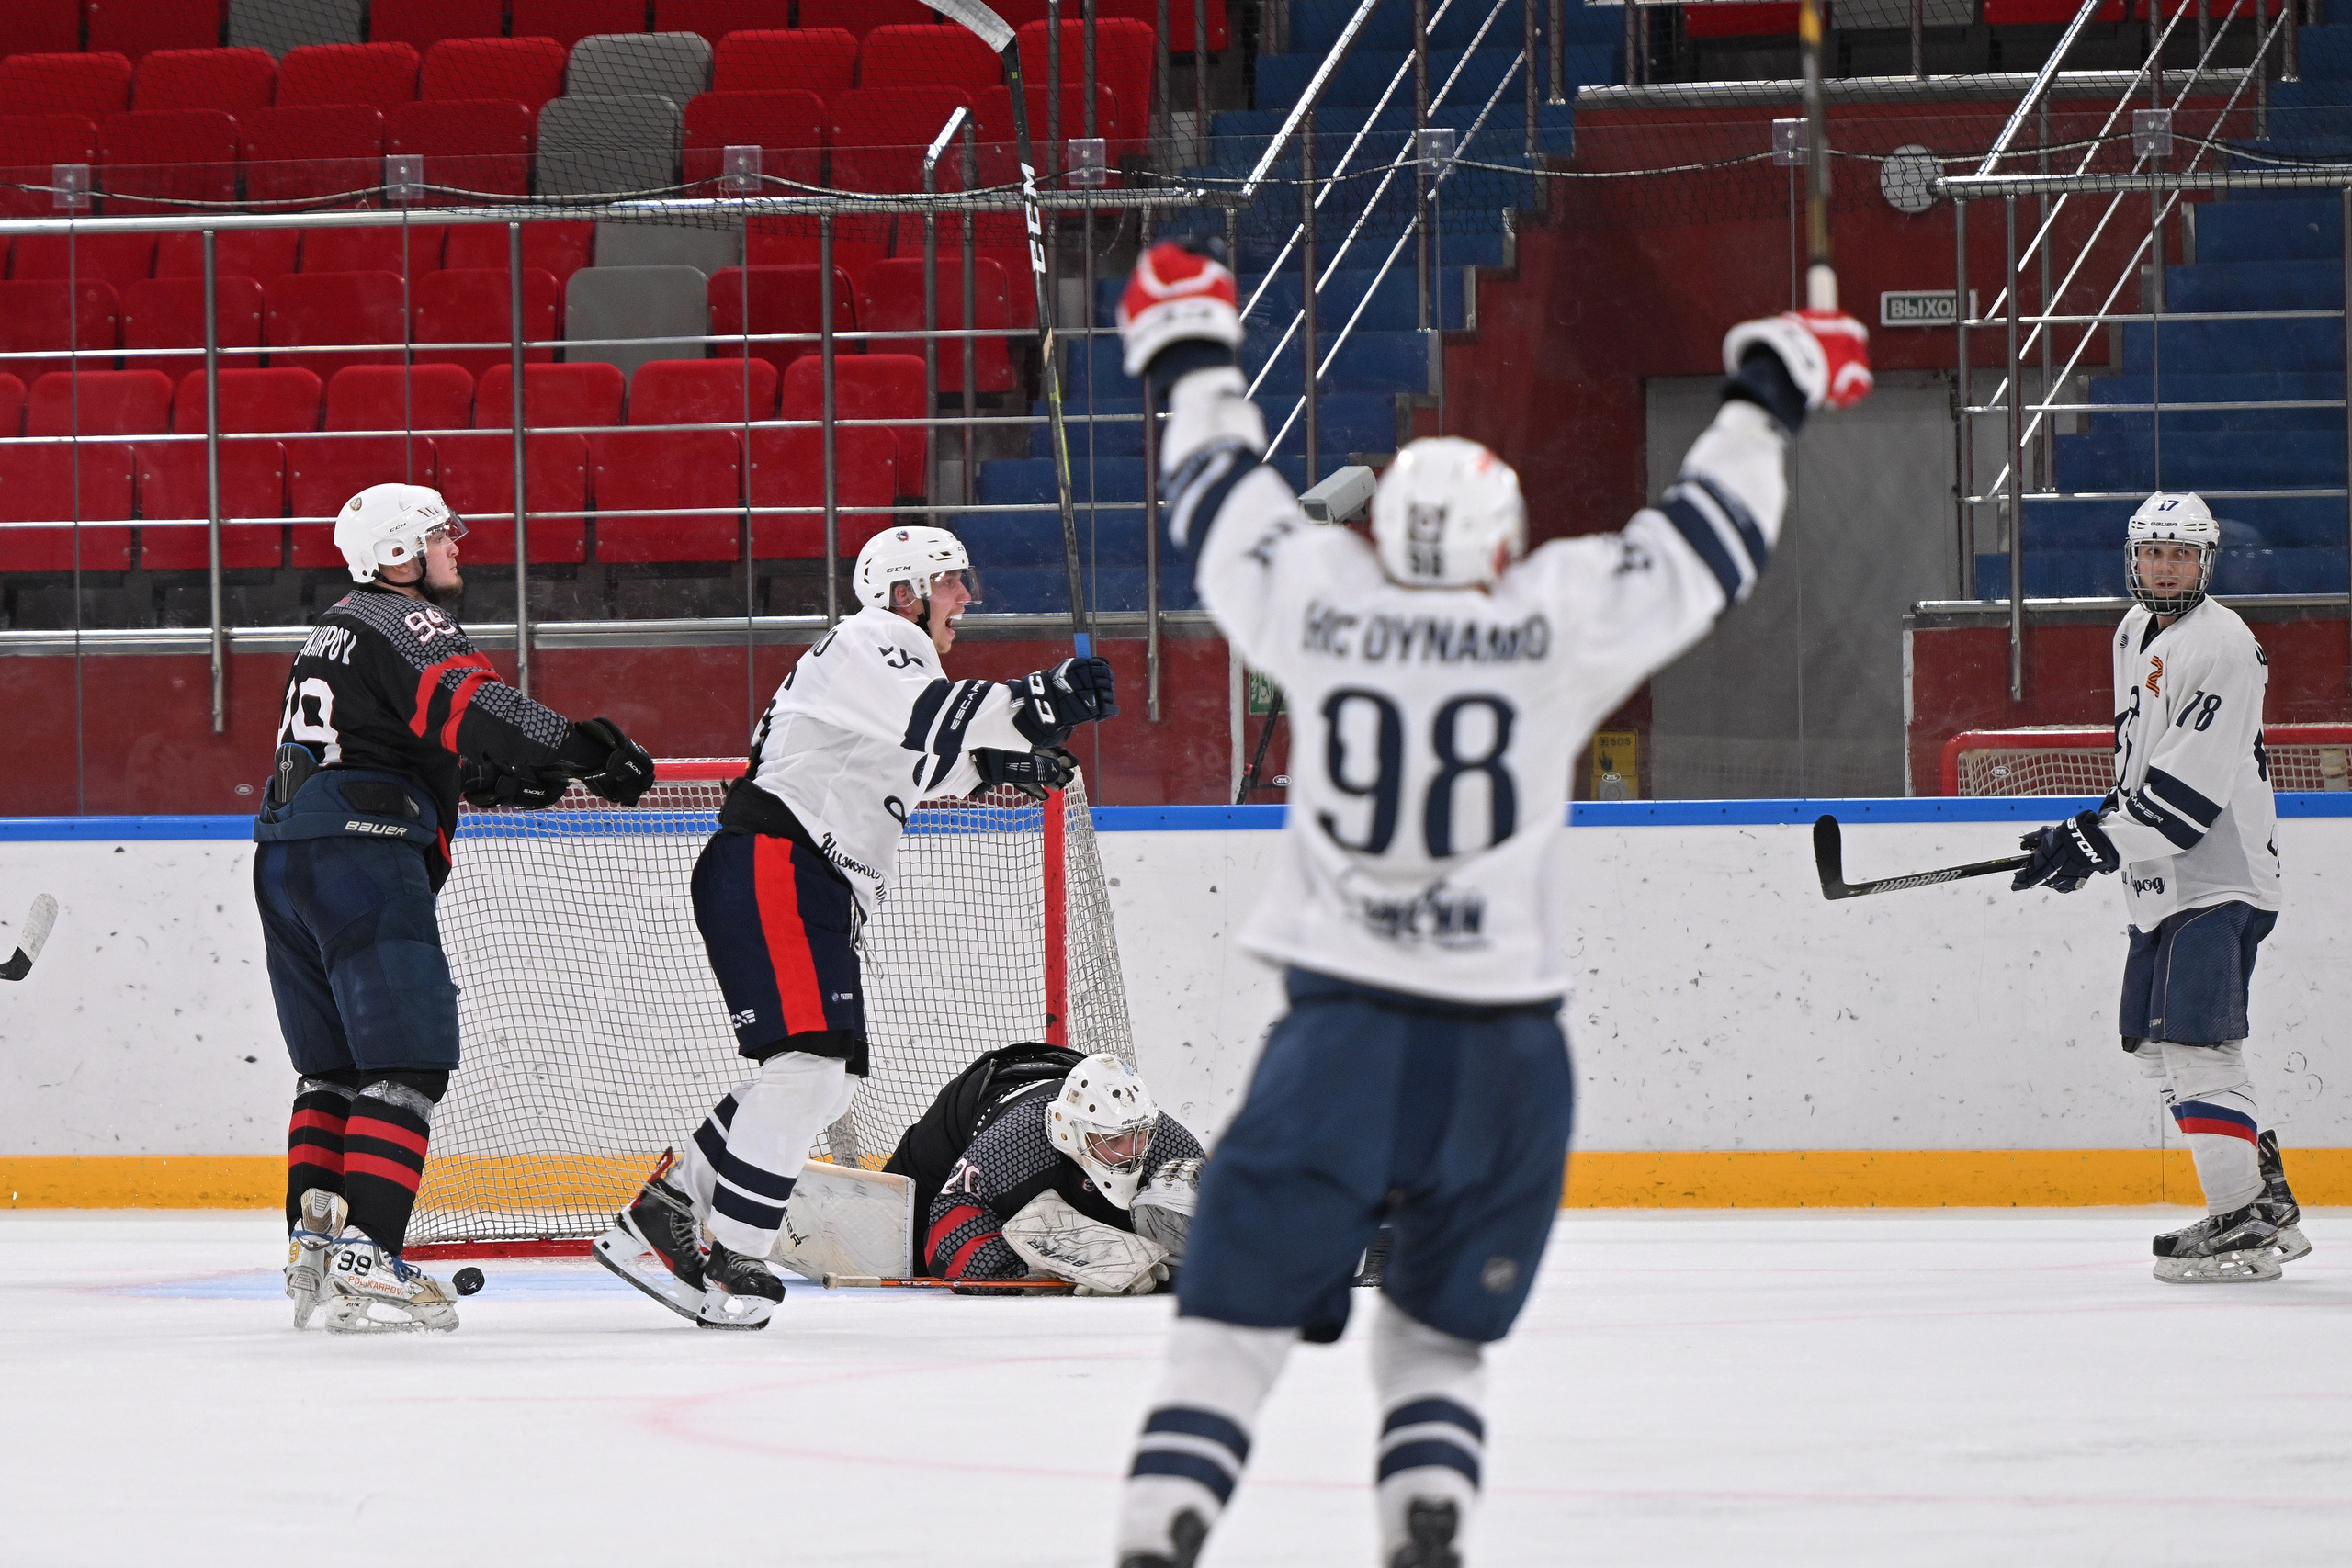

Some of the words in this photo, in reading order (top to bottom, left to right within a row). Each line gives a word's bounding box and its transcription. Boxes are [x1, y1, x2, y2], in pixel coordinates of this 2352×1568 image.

[1021, 162, 1046, 273] CCM
[2158, 500, 2180, 511] 17
[390, 522, 406, 533] CCM
[887, 565, 911, 573] CCM
[404, 607, 457, 644] 99
[1361, 613, 1552, 663] DYNAMO
[1029, 671, 1057, 725] CC
[2176, 690, 2222, 732] 78
[1611, 736, 1632, 747] SOS
[624, 760, 643, 776] TACKS
[1317, 686, 1520, 860] 98
[344, 820, 408, 837] BAUER
[1871, 869, 1962, 895] WARRIOR
[337, 1249, 373, 1277] 99
[348, 1274, 403, 1296] POLIKARPOV
